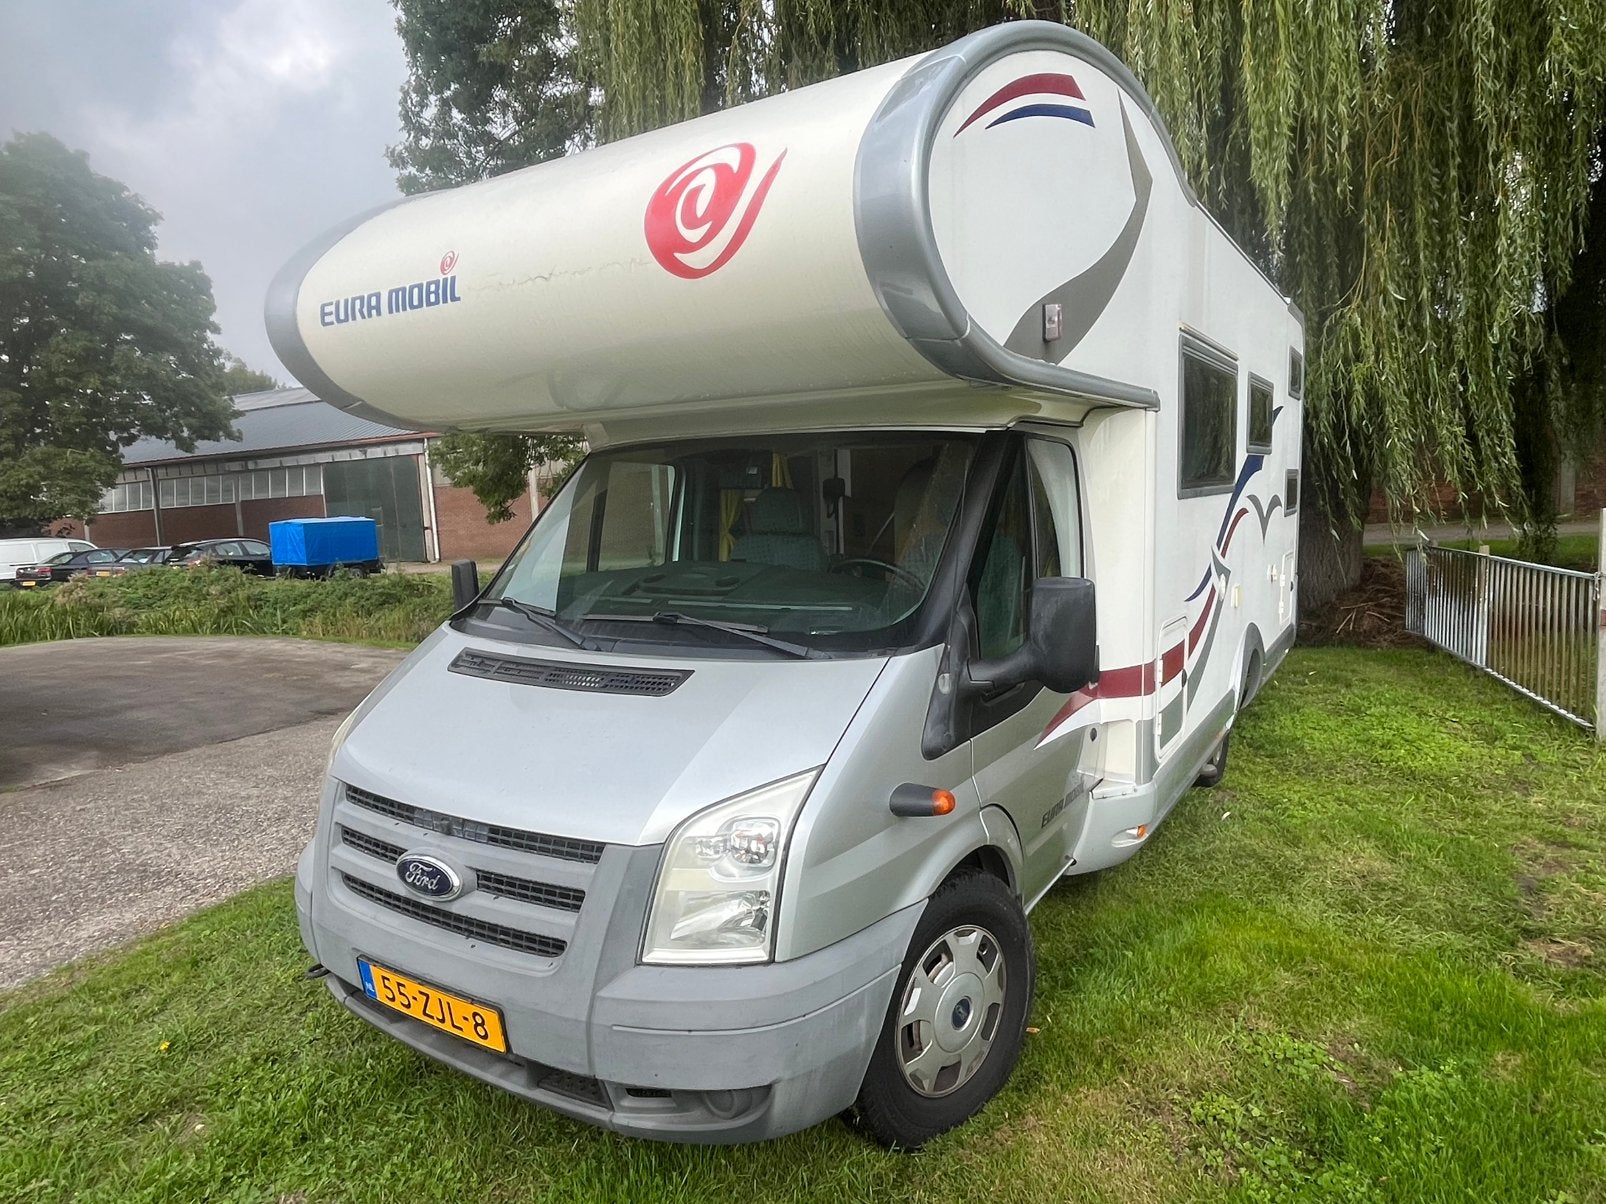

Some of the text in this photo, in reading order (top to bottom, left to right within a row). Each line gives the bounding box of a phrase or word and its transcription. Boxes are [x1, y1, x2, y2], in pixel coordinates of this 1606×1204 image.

[320, 275, 461, 327] EURA MOBIL
[405, 862, 441, 890] Ford
[381, 975, 489, 1041] 55-ZJL-8
